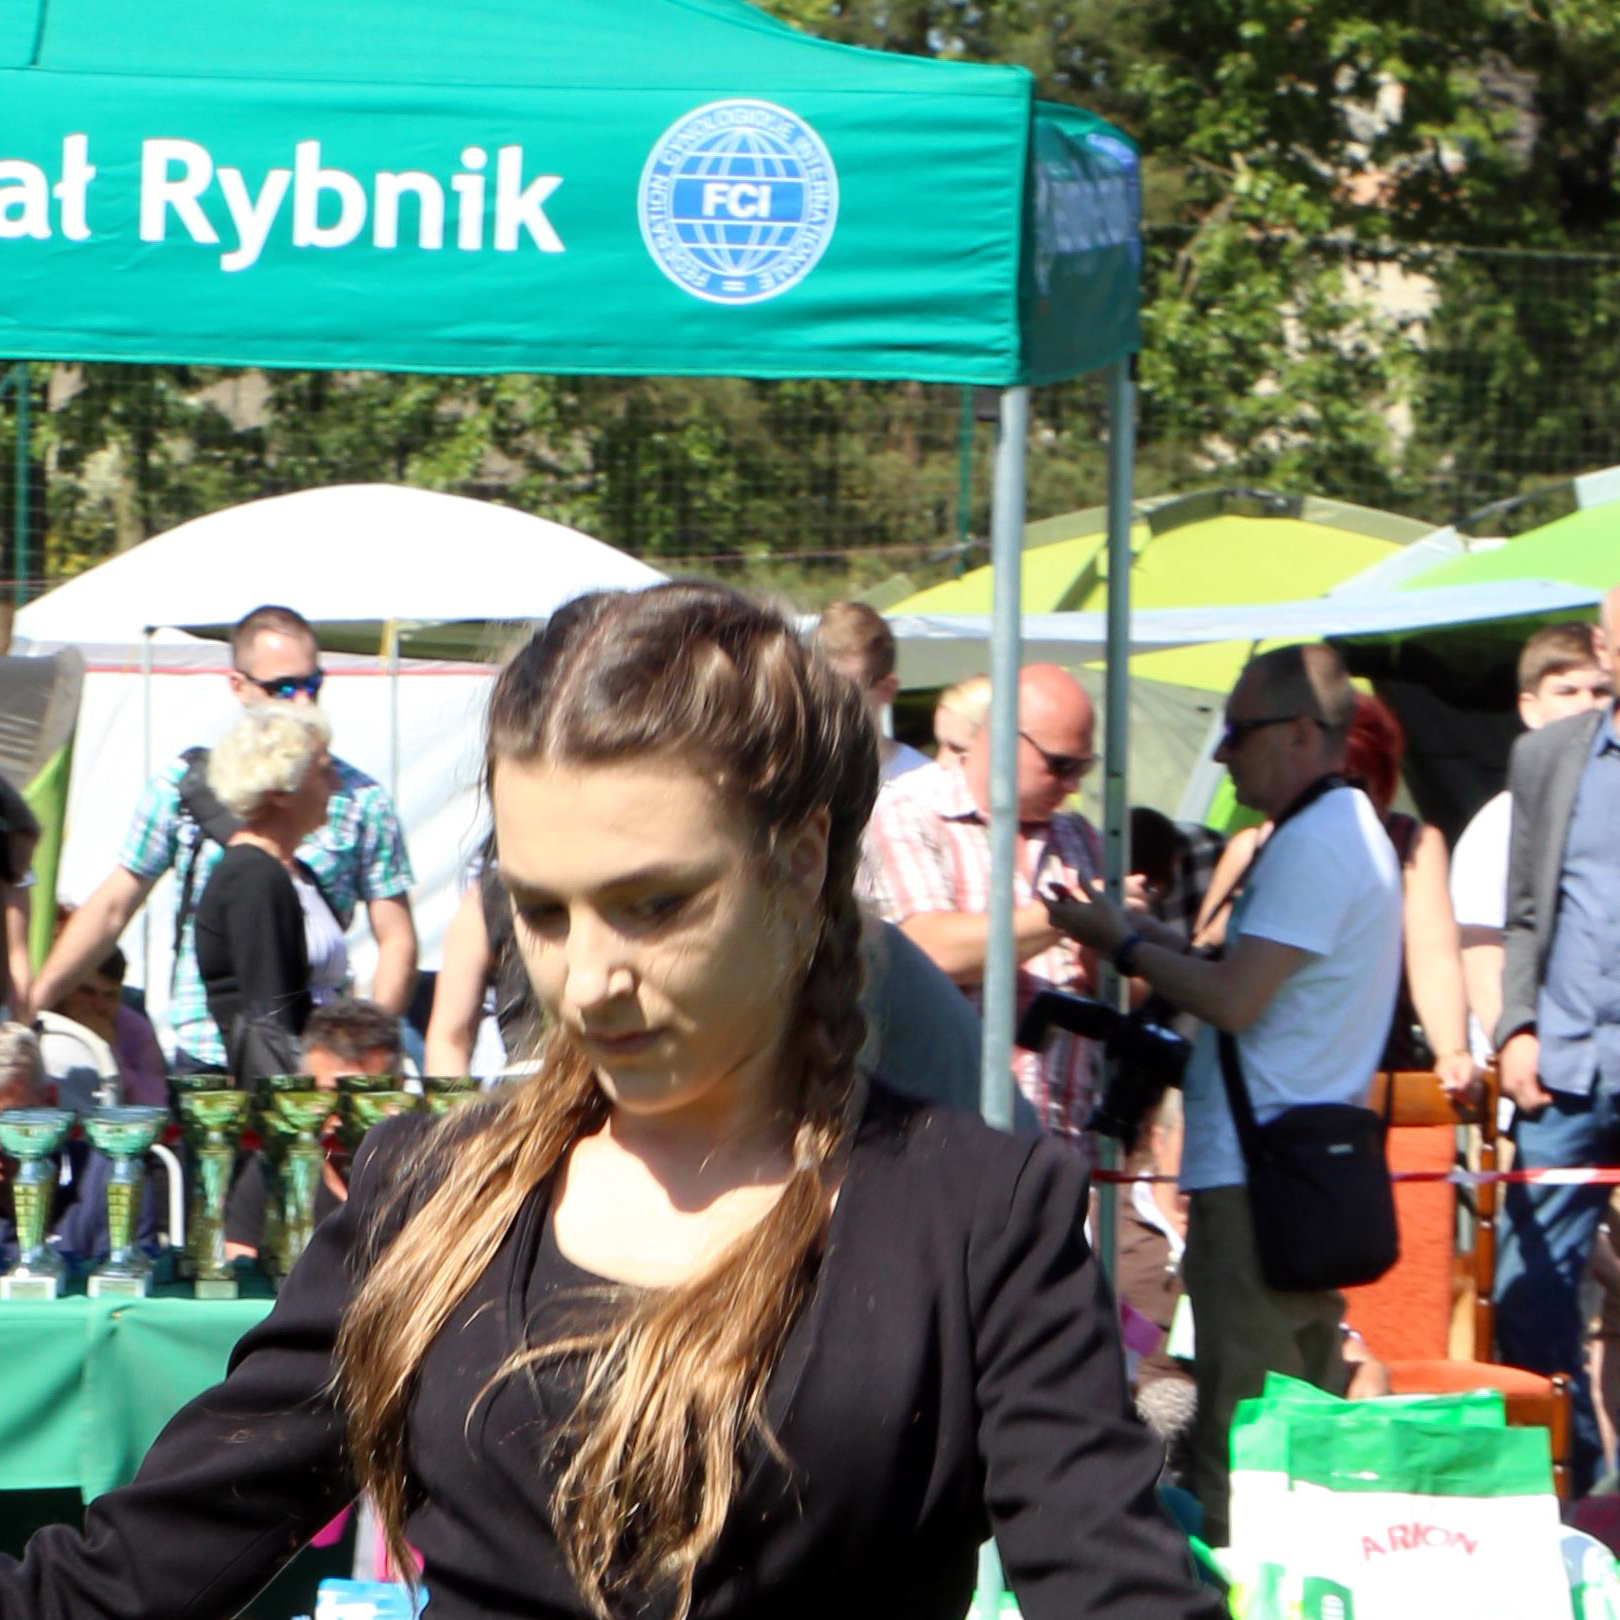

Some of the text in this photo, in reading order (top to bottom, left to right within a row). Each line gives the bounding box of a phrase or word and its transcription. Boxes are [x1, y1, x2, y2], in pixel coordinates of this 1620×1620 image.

[140, 138, 566, 273] Rybnik
[702, 182, 773, 218] FCI
[1361, 1521, 1478, 1560] ARION
